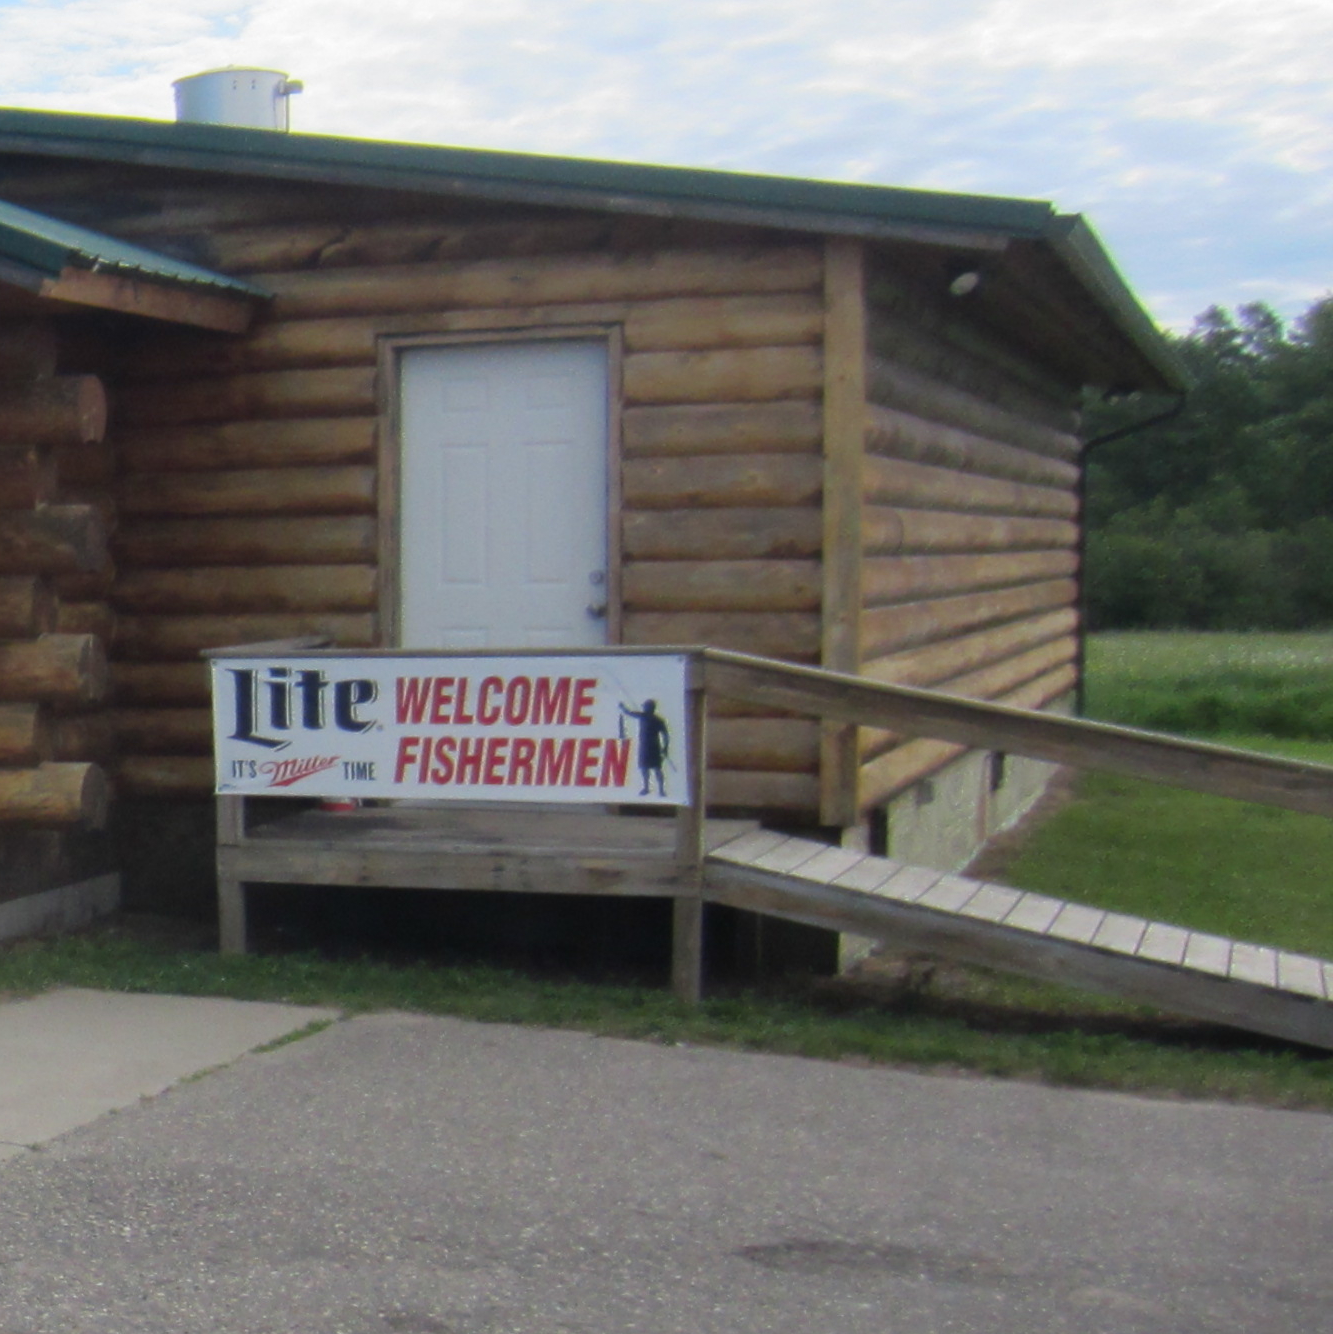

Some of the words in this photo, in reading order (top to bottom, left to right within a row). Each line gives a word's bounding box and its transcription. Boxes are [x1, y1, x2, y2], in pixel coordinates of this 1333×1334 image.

[225, 667, 379, 752] Lite
[395, 675, 598, 726] WELCOME
[232, 759, 258, 779] IT'S
[260, 755, 341, 787] Miller
[342, 761, 376, 781] TIME
[393, 736, 631, 787] FISHERMEN
